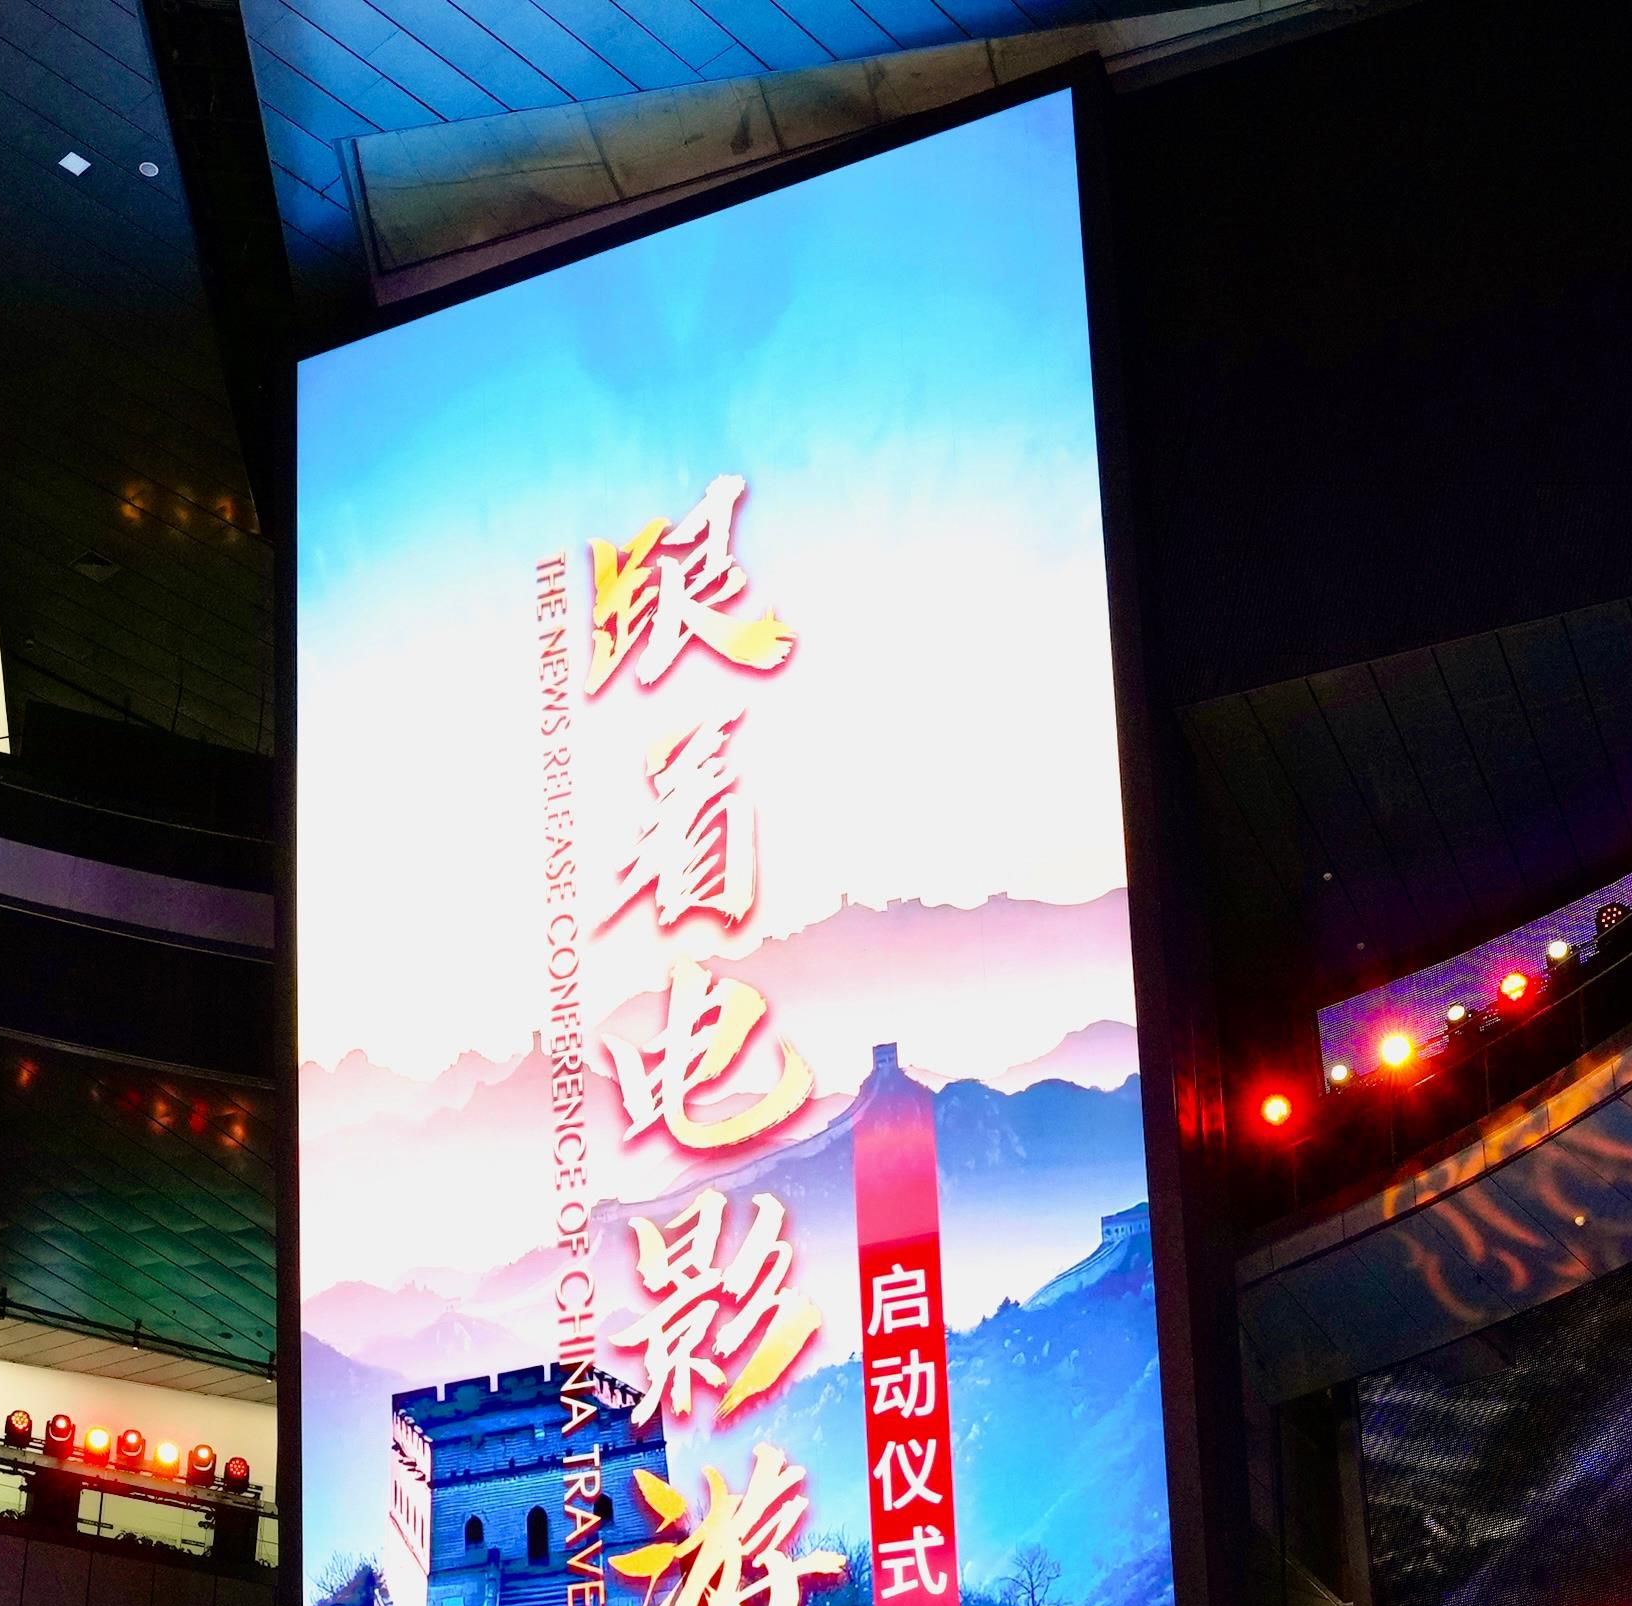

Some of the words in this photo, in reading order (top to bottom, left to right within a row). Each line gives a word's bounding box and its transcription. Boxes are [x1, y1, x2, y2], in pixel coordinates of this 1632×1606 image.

[536, 554, 567, 622] THE
[539, 625, 571, 736] NEWS
[542, 747, 578, 903] RELEASE
[547, 914, 589, 1191] CONFERENCE
[556, 1201, 592, 1257] OF
[556, 1271, 598, 1434] CHINA
[865, 1264, 948, 1599] 启动仪式
